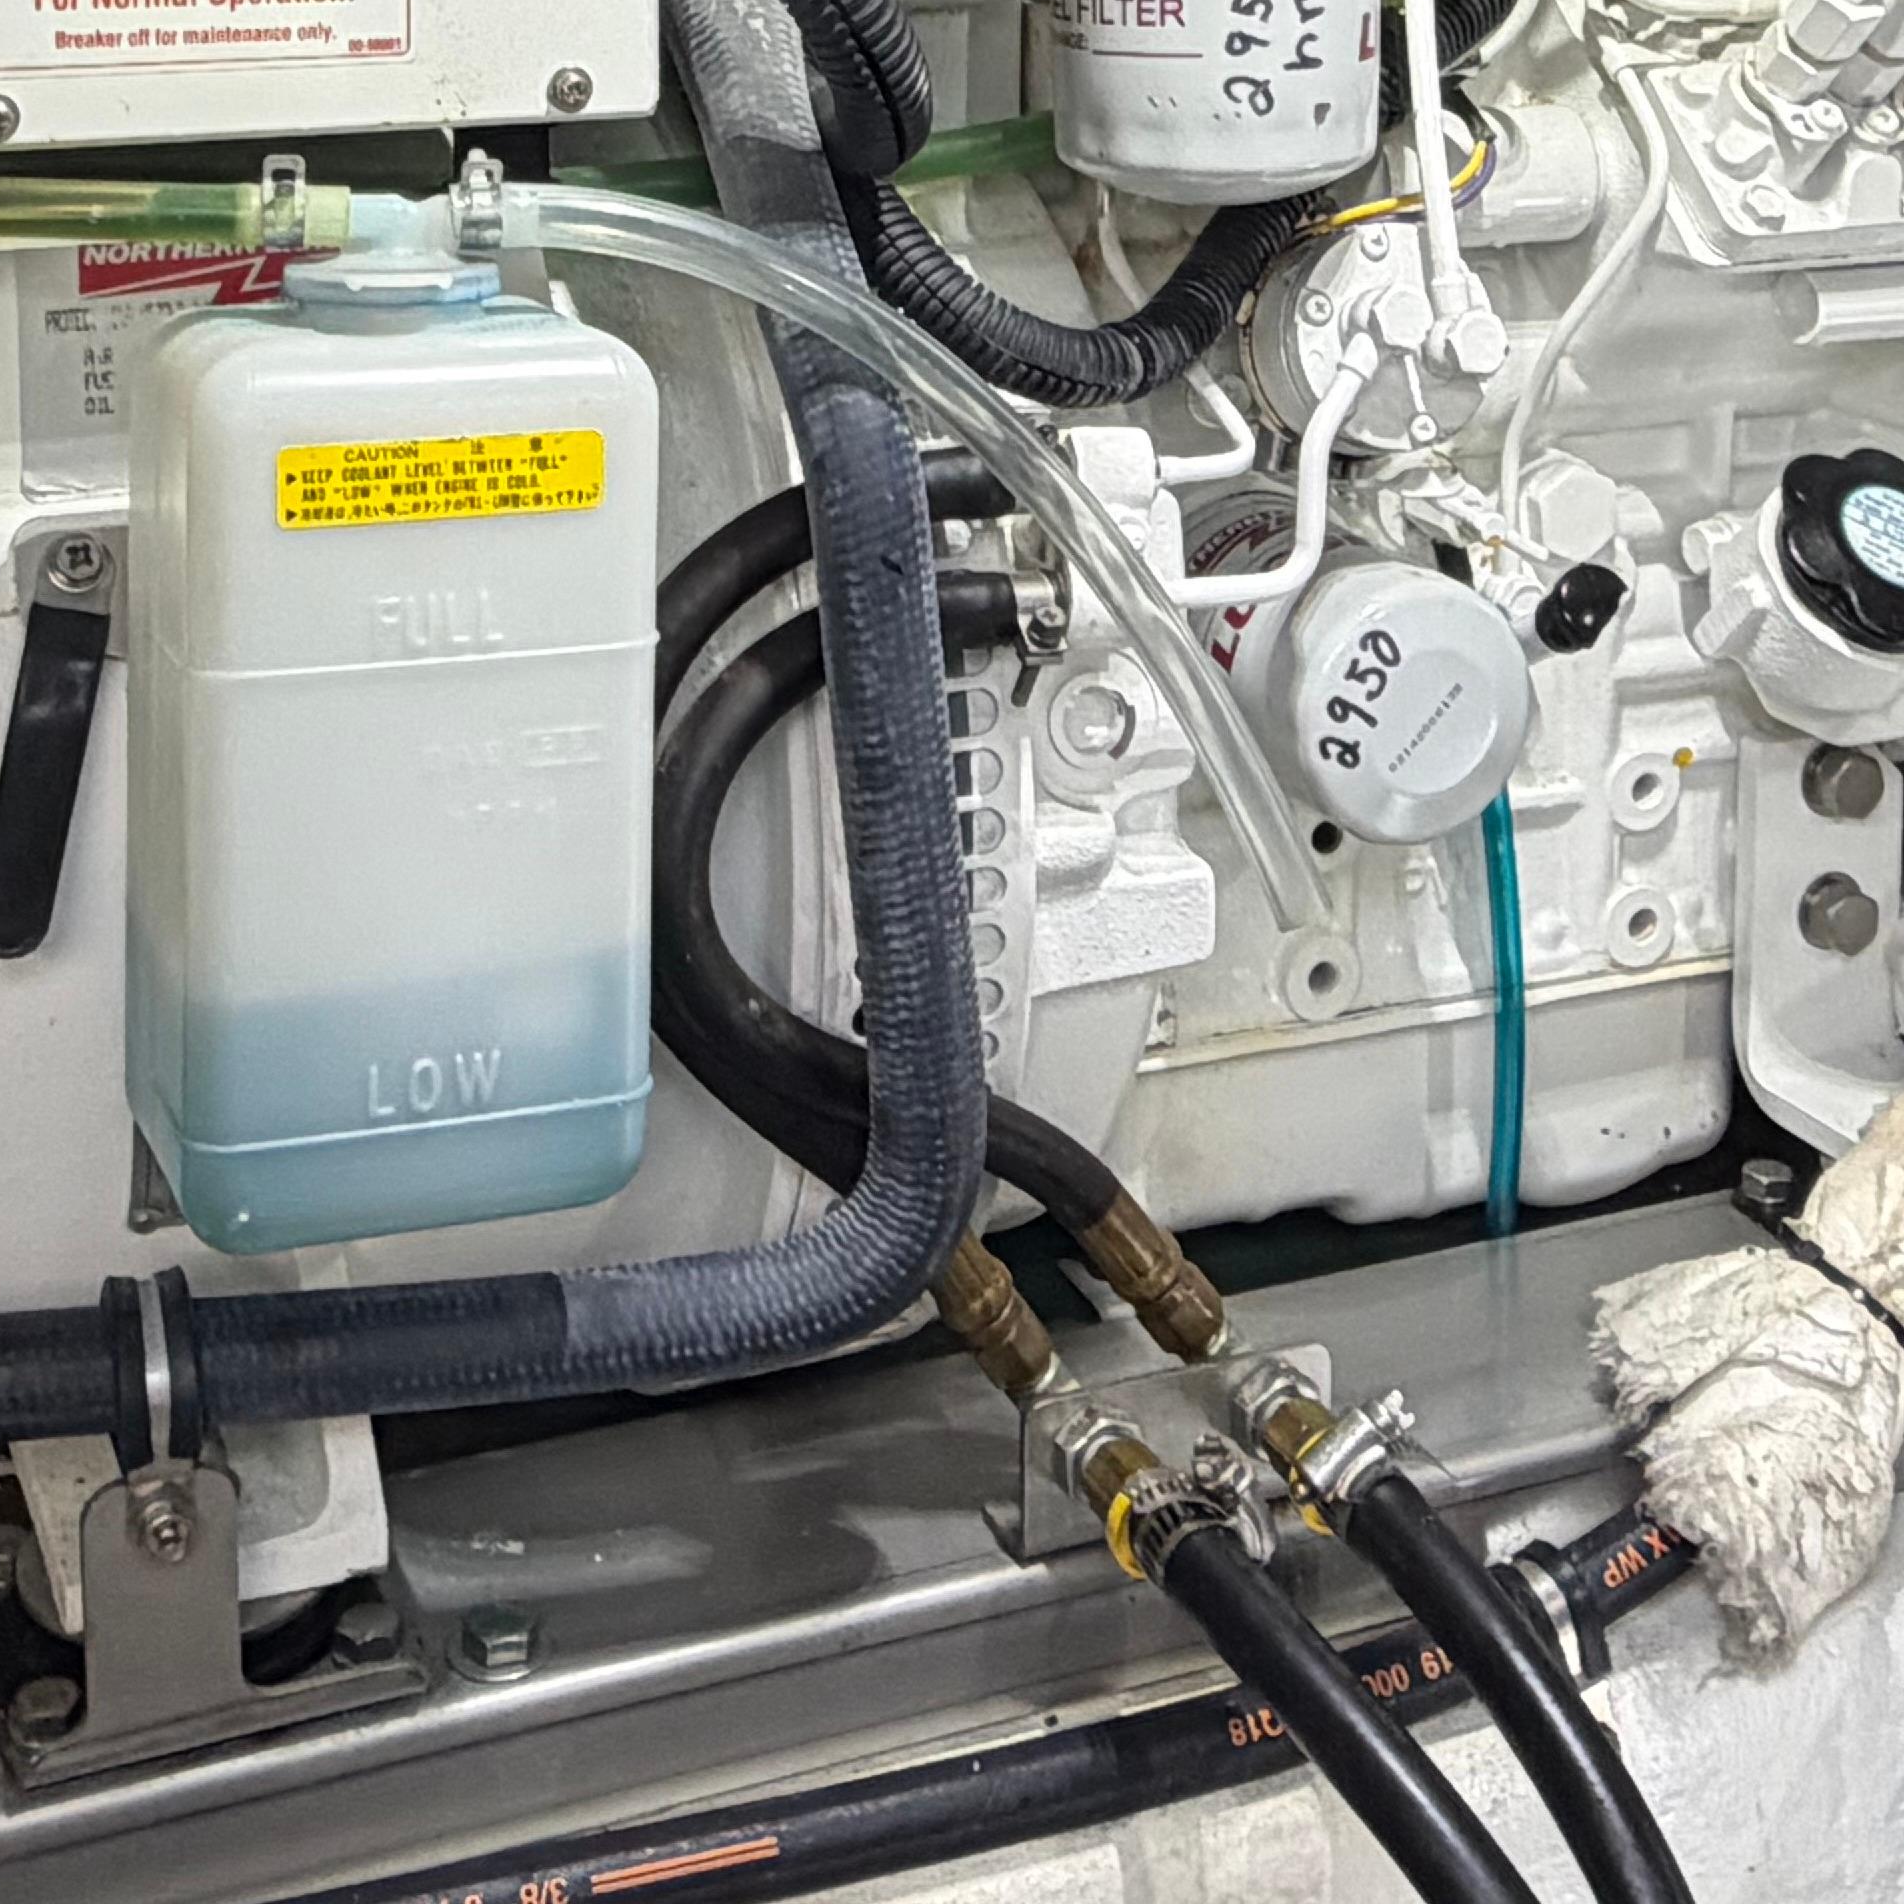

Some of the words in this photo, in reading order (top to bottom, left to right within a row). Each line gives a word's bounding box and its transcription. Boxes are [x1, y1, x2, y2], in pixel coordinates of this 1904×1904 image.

[54, 30, 123, 50] Breaker
[128, 29, 151, 48] off
[154, 29, 178, 47] for
[297, 23, 338, 45] only.
[300, 467, 334, 485] KEEP
[341, 463, 397, 483] COOLANT
[404, 460, 444, 479] LEVEL
[452, 456, 514, 476] BETWEEN
[343, 447, 420, 464] CAUTION
[301, 486, 327, 503] AND
[390, 480, 429, 498] WHEN
[434, 477, 479, 496] ENGINE
[371, 589, 505, 648] FULL
[1317, 628, 1402, 771] 2950
[368, 1048, 502, 1119] LOW
[1603, 1544, 1648, 1590] WP
